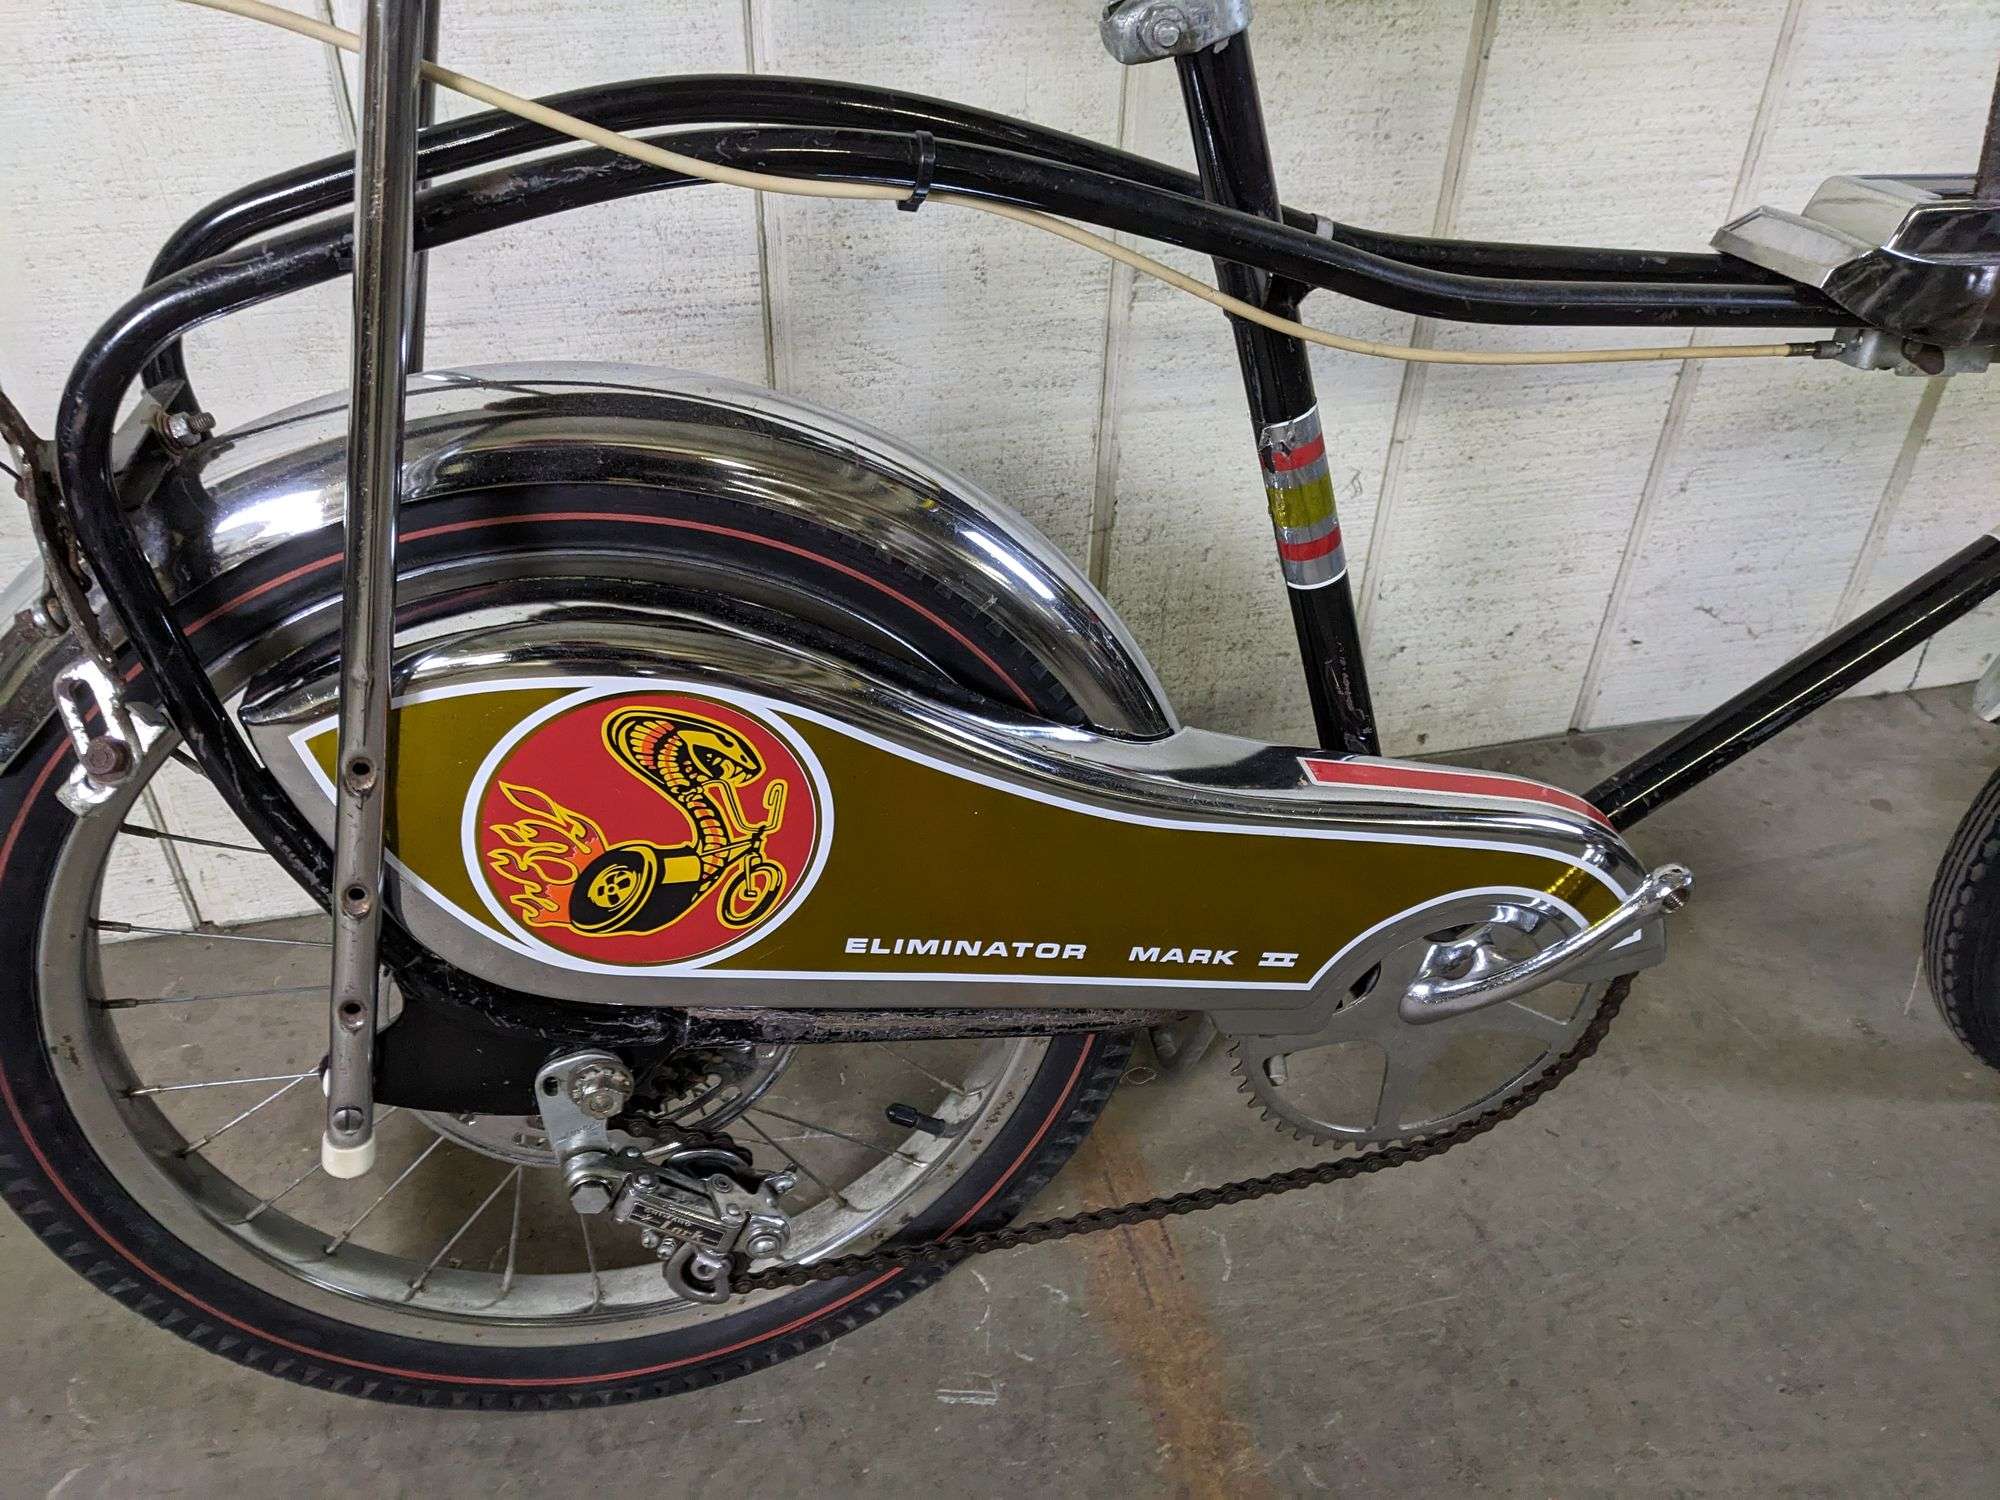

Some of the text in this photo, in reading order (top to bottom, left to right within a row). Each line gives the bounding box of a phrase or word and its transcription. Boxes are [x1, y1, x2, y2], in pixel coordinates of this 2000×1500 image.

[845, 938, 1300, 968] ELIMINATOR MARK II
